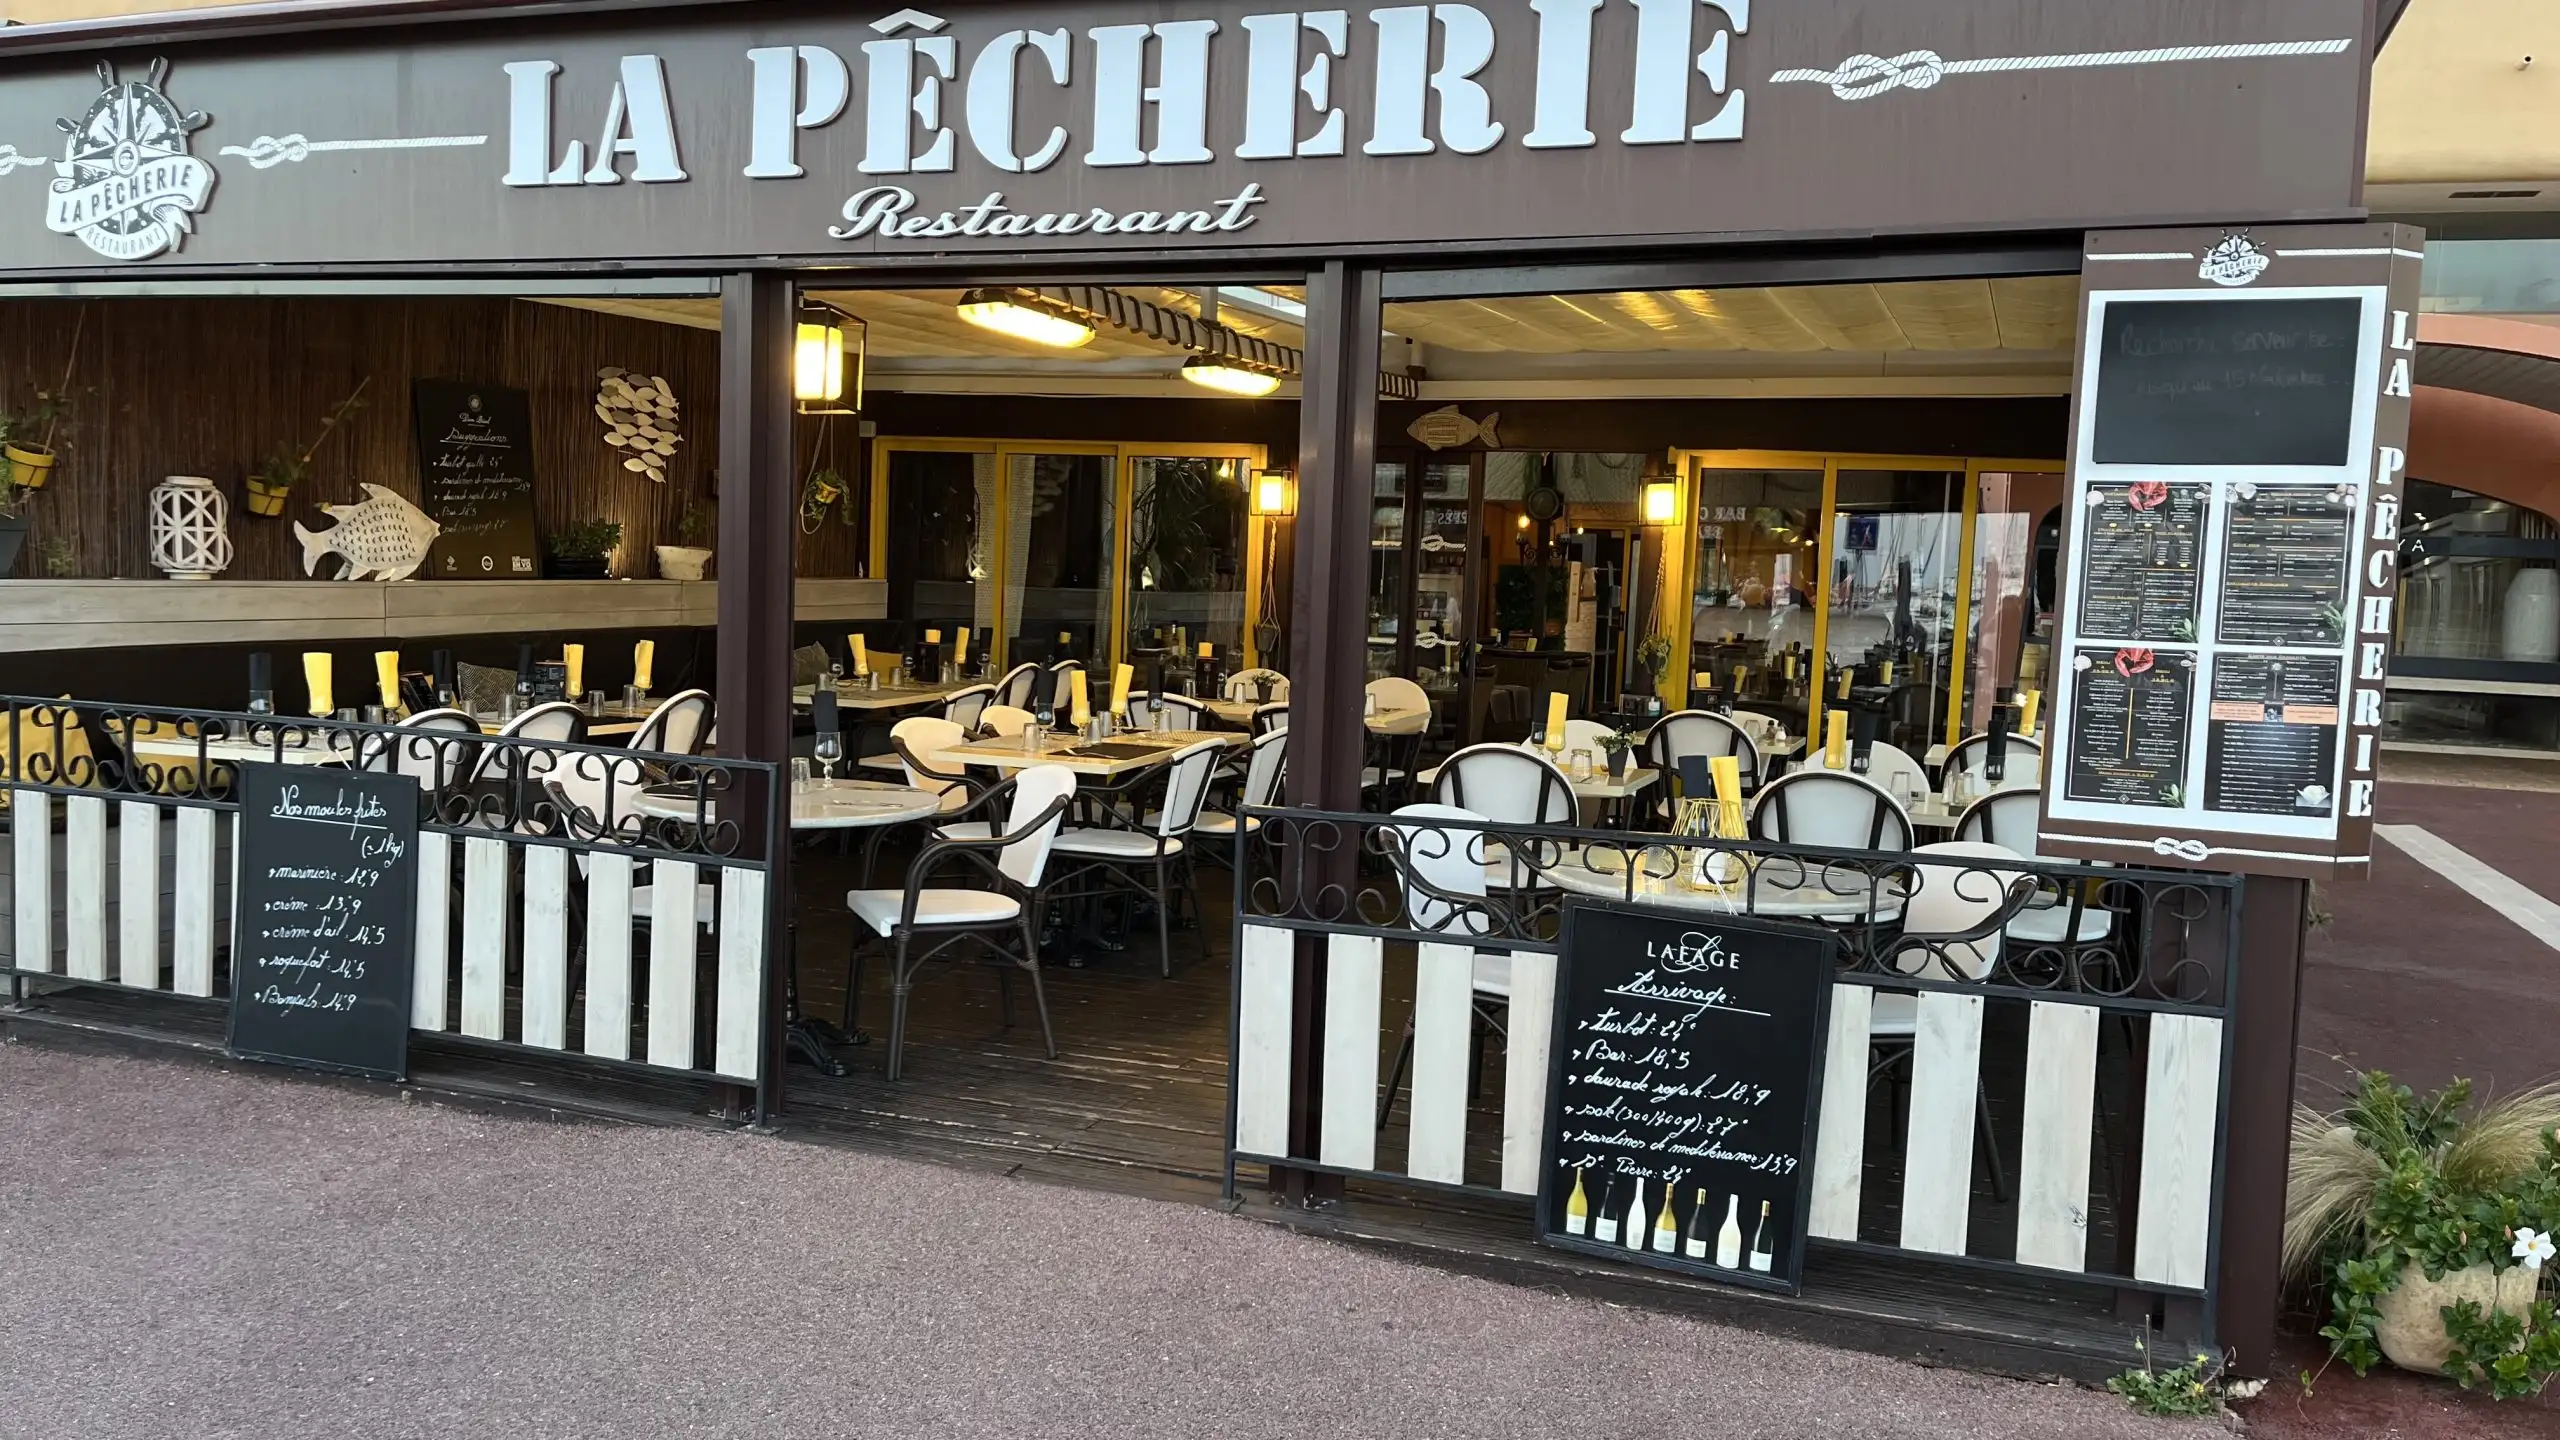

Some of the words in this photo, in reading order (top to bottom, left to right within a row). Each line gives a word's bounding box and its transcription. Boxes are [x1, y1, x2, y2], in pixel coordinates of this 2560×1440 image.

[503, 54, 687, 187] LA
[743, 0, 1750, 179] PÊCHERIE
[60, 200, 82, 224] LA
[91, 164, 193, 217] PÊCHERIE
[828, 184, 1266, 240] Restaurant
[86, 227, 163, 255] RESTAURANT
[2383, 310, 2414, 397] LA
[2346, 446, 2405, 818] PÊCHERIE
[1647, 940, 1740, 970] LAFAGE
